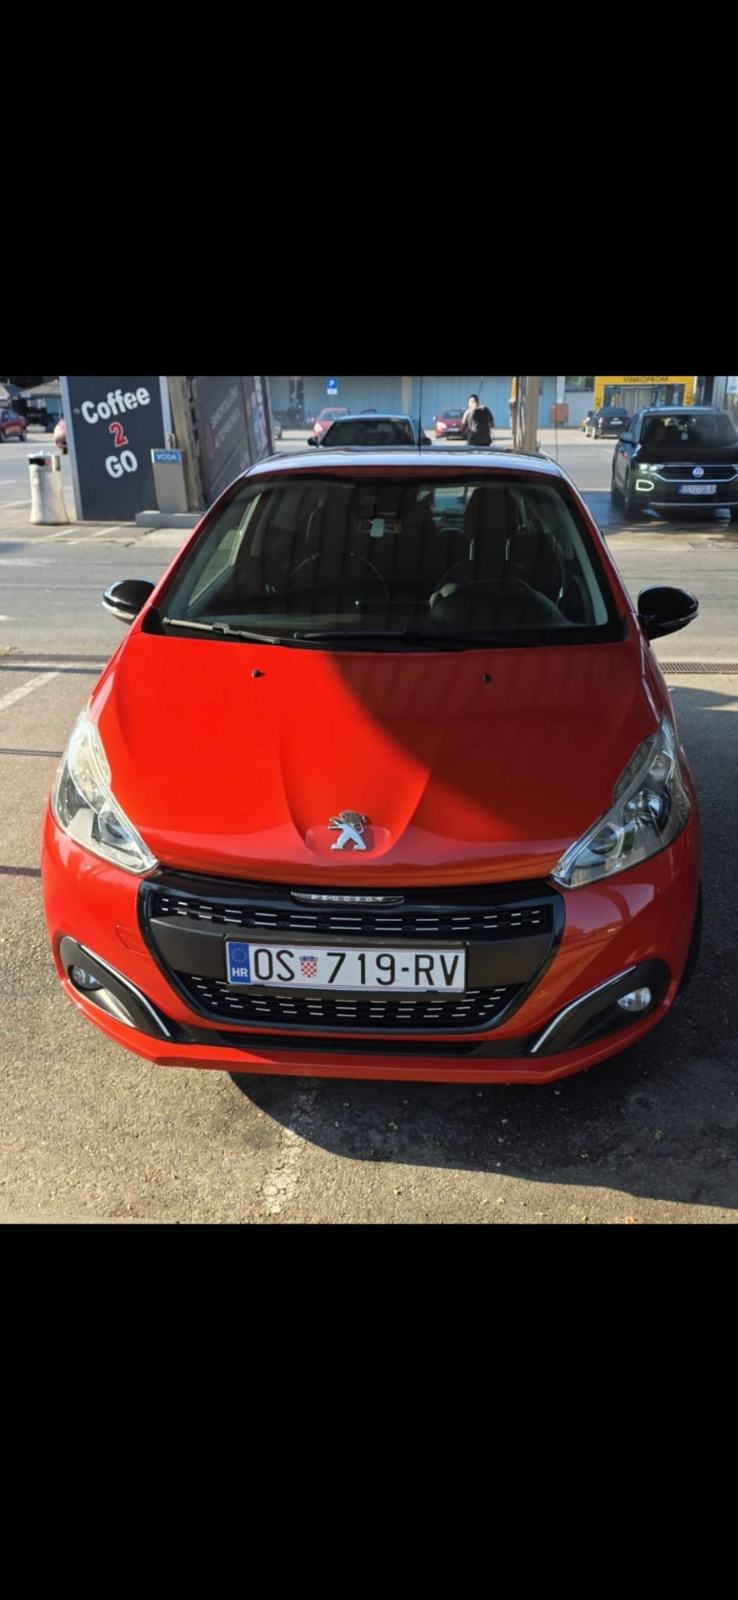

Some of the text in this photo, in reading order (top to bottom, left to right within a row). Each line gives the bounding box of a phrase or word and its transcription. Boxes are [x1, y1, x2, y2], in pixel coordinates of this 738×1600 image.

[81, 387, 150, 424] Coffee
[108, 421, 128, 447] 2
[105, 450, 138, 478] GO
[311, 894, 384, 903] PEUGEOT
[232, 967, 248, 978] HR
[254, 948, 459, 986] OS 719-RV
